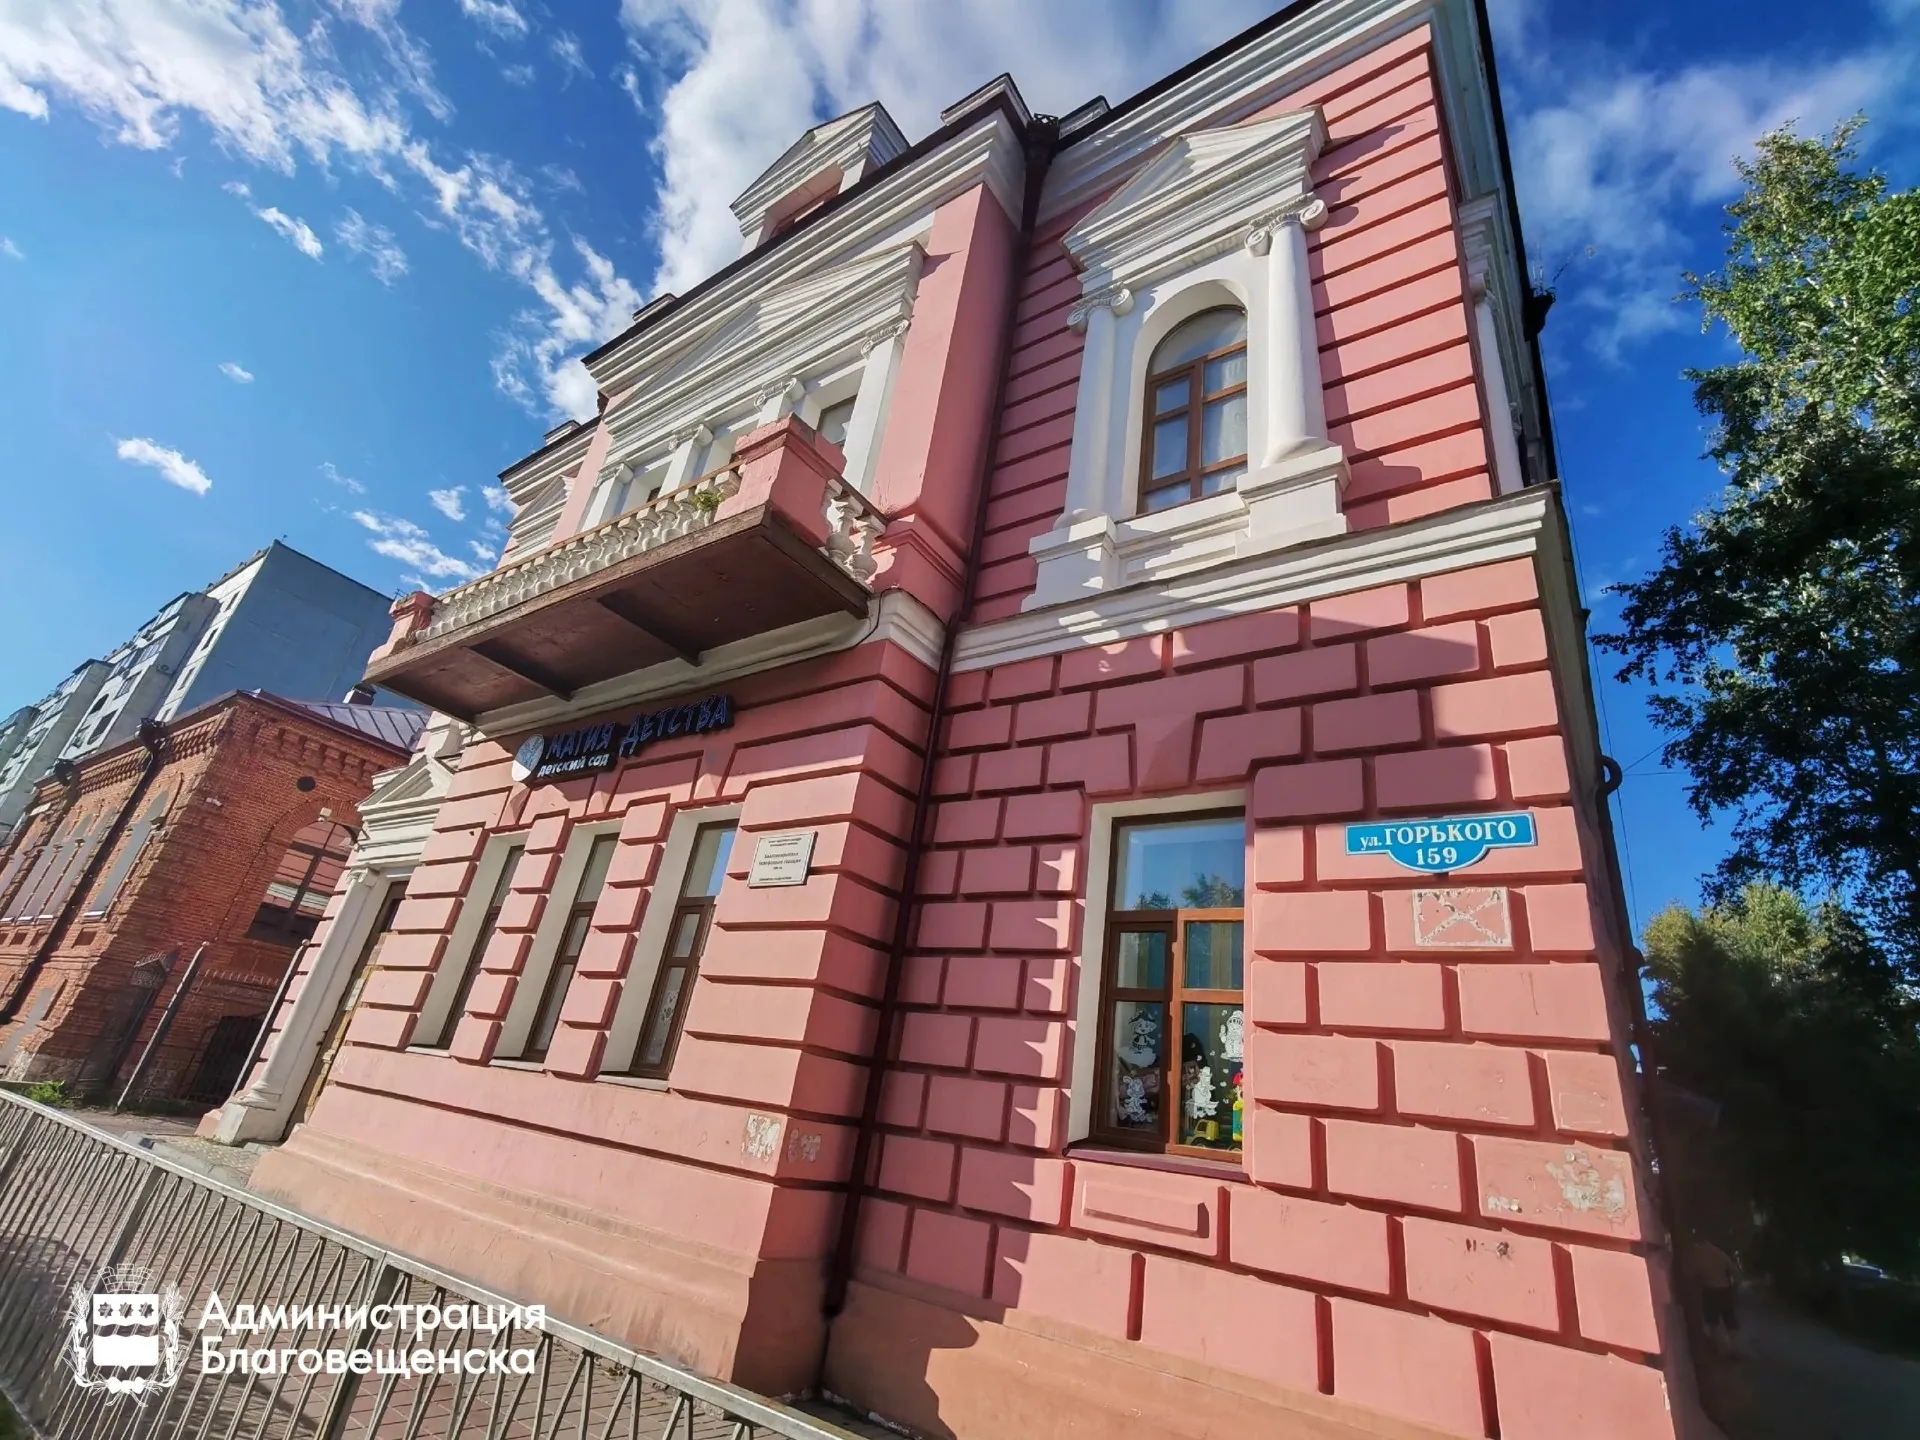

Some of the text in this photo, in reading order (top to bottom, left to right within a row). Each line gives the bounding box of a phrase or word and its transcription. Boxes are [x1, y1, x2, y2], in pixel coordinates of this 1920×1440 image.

[546, 694, 728, 759] МАГИЯ ДЕТСТВА
[536, 756, 586, 778] детский
[1360, 820, 1517, 851] ул. ГОРЬКОГО
[1416, 847, 1458, 866] 159
